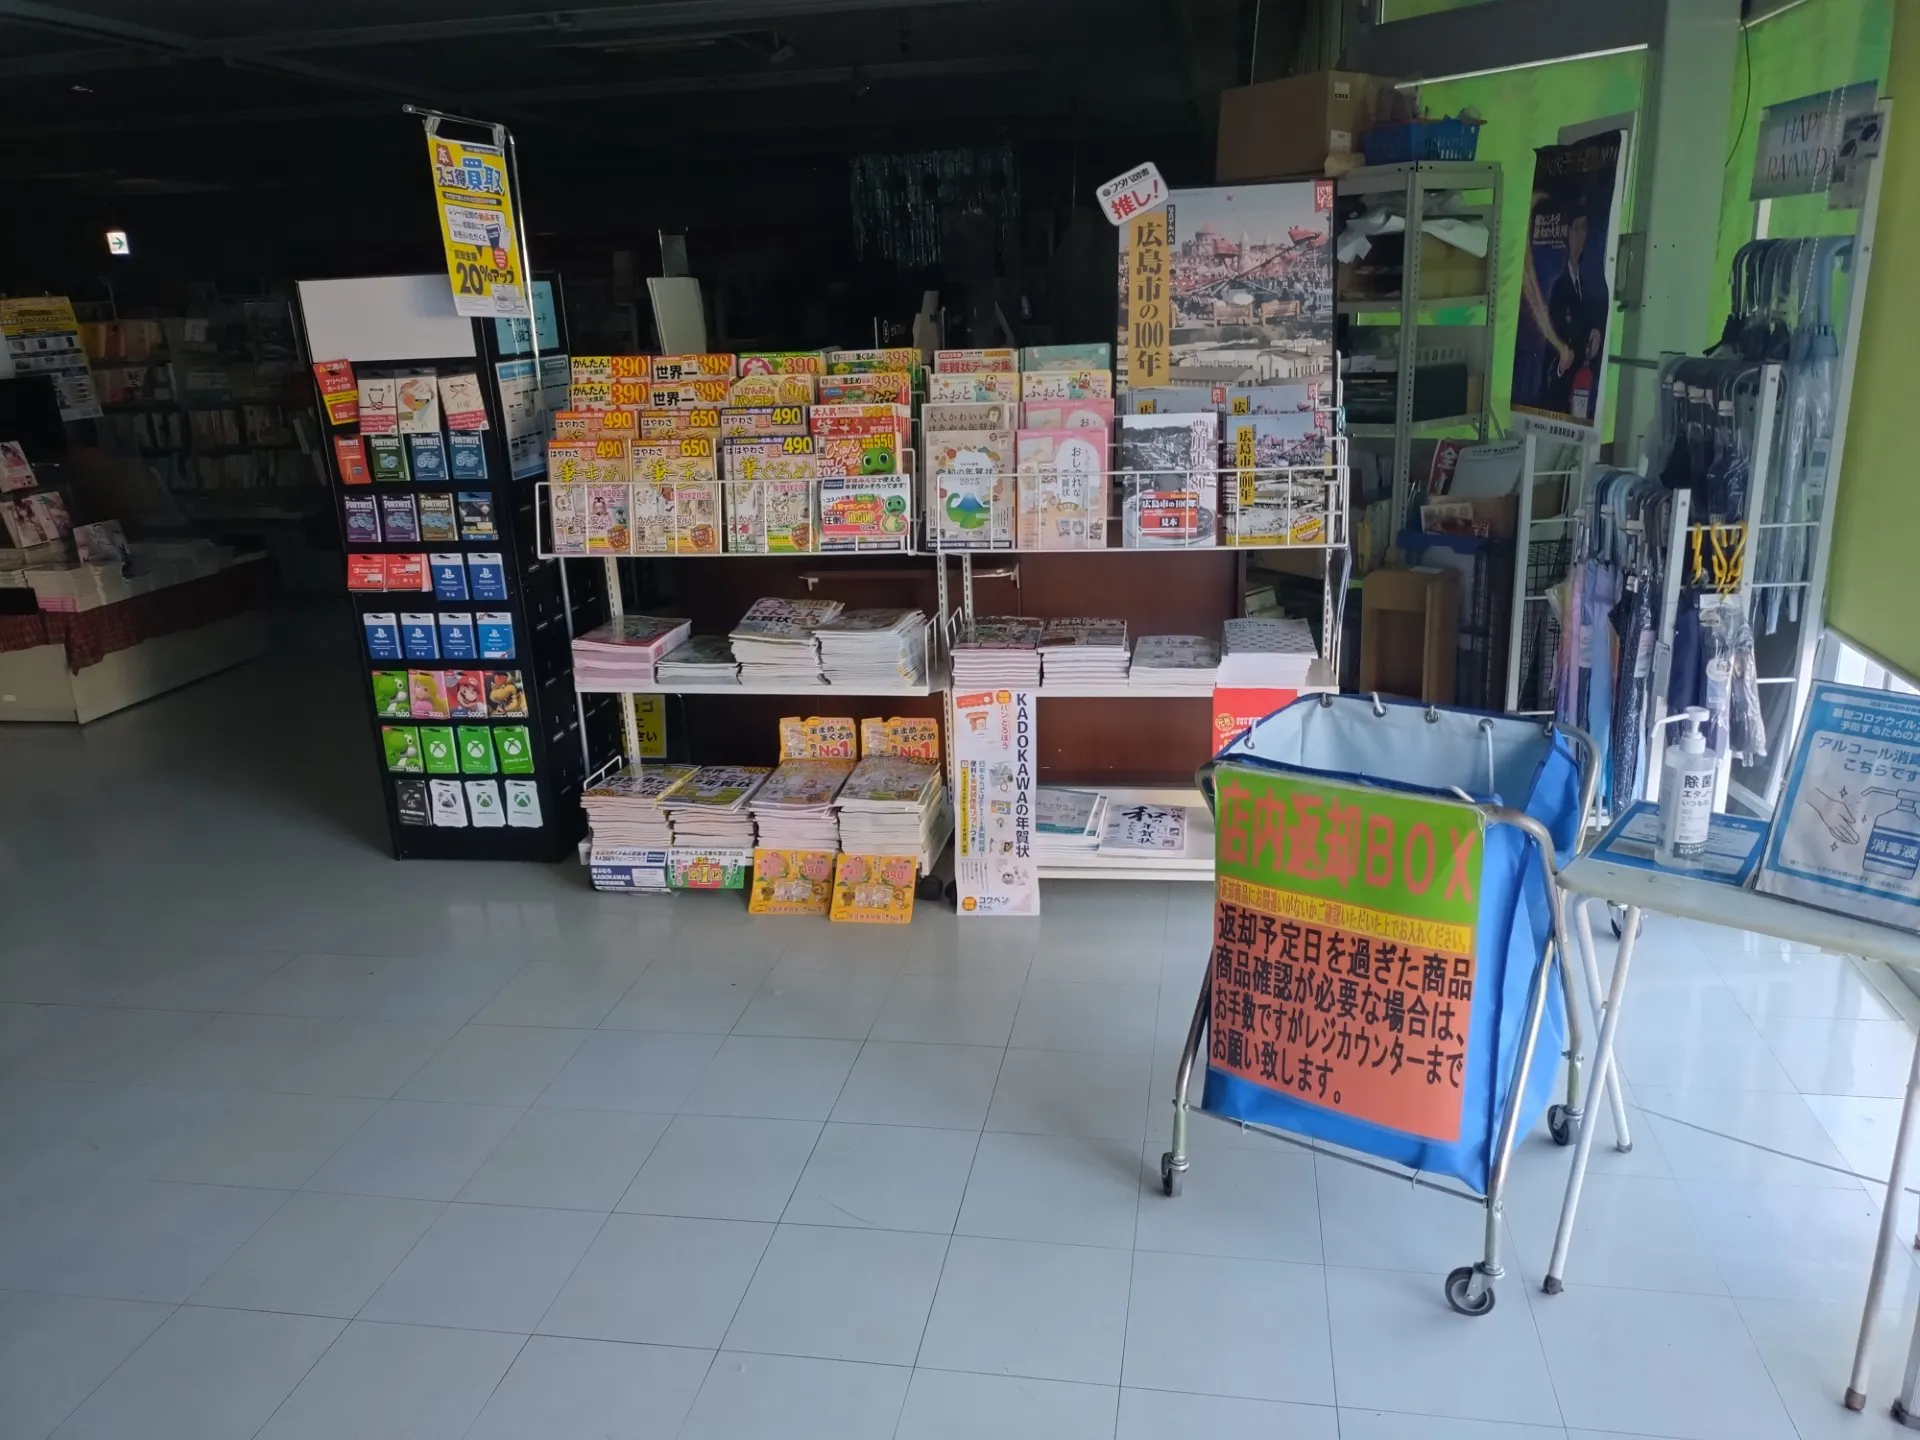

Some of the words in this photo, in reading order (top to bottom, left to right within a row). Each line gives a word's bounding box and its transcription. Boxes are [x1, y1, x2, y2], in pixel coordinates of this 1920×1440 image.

[1135, 221, 1165, 378] 広島市の100年
[573, 358, 610, 368] かんたん!
[699, 355, 729, 376] 398
[784, 357, 817, 374] 390
[885, 351, 910, 364] 398
[612, 357, 647, 378] 390
[656, 364, 697, 380] 世界一
[940, 361, 1011, 373] 年賀状データ集
[874, 375, 899, 389] 398
[573, 385, 610, 396] かんたん!
[612, 383, 647, 404] 390
[653, 391, 695, 407] 世界一
[556, 418, 585, 428] はやわざ
[603, 411, 632, 429] 490
[643, 418, 672, 427] はやわざ
[689, 410, 718, 427] 650
[723, 416, 753, 425] はやわざ
[771, 407, 800, 425] 490
[596, 441, 624, 457] 490
[680, 439, 710, 457] 650
[782, 437, 813, 455] 490
[874, 434, 895, 449] 550
[550, 450, 579, 458] はやわざ
[633, 449, 663, 457] はやわざ
[734, 446, 765, 455] はやわざ
[554, 459, 625, 490] 筆まめ
[643, 458, 704, 492] 筆王
[738, 456, 814, 480] 筆ぐるめ
[817, 467, 847, 477] 2025
[959, 478, 981, 486] 2025
[1160, 517, 1178, 528] 見本
[1817, 736, 1920, 766] アルコール消
[1015, 693, 1030, 858] KADOKAWAの年賀状
[1844, 758, 1918, 783] こちらです
[1684, 774, 1712, 788] 除菌
[1682, 790, 1712, 798] エタノ
[1218, 777, 1475, 903] 店内返却BOX
[1872, 838, 1919, 860] 消毒液
[801, 864, 822, 875] 490
[883, 871, 905, 881] 490
[1218, 902, 1472, 1002] 返却予定日を過ぎた商品
[1216, 943, 1465, 1045] 商品確認が必要な場合は、
[1214, 987, 1463, 1088] お手数ですがレジカウンターまで
[1213, 1028, 1342, 1105] お願い致します。
